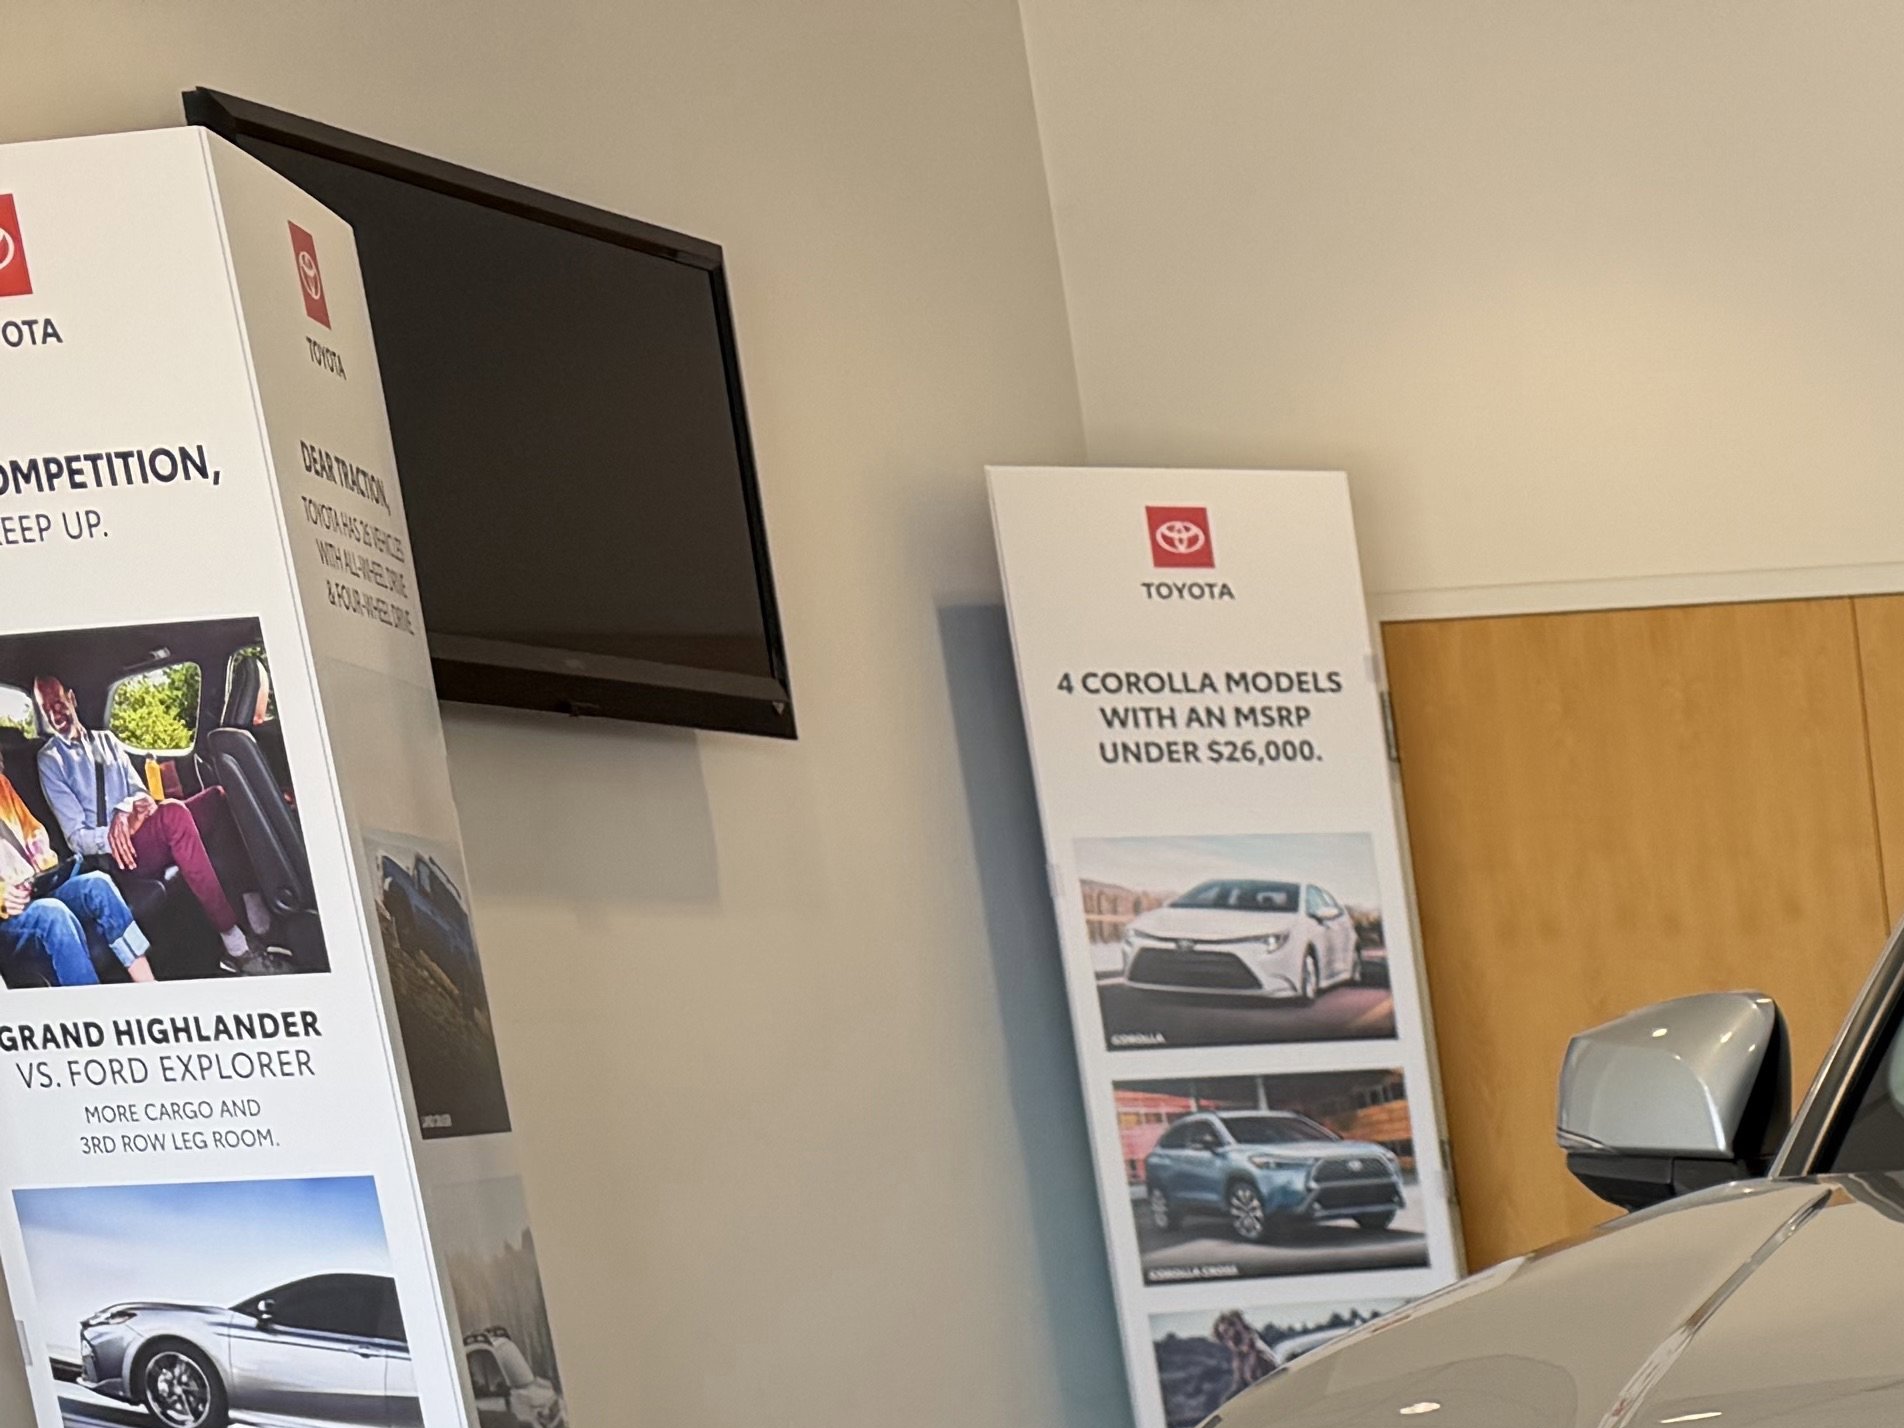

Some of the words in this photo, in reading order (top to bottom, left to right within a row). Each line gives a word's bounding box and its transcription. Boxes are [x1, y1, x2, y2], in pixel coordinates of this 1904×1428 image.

[306, 336, 347, 380] TOYOTA
[301, 439, 337, 485] DEAR
[334, 455, 391, 517] TRACTION,
[0, 513, 51, 545] EEP
[62, 510, 108, 539] UP.
[301, 495, 340, 533] TOYOTA
[340, 511, 362, 543] HAS
[316, 538, 344, 570] WITH
[1141, 582, 1236, 600] TOYOTA
[1057, 672, 1074, 694] 4
[1081, 671, 1218, 694] COROLLA
[1225, 671, 1343, 693] MODELS
[1099, 706, 1177, 729] WITH
[1185, 706, 1226, 728] AN
[1235, 705, 1311, 728] MSRP
[1099, 741, 1202, 764] UNDER
[1207, 739, 1323, 766] $26,000.
[0, 1021, 104, 1051] GRAND
[112, 1010, 322, 1046] HIGHLANDER
[16, 1061, 61, 1088] VS.
[67, 1057, 148, 1087] FORD
[160, 1049, 315, 1082] EXPLORER
[85, 1103, 140, 1124] MORE
[144, 1100, 213, 1122] CARGO
[220, 1098, 261, 1118] AND
[80, 1135, 116, 1154] 3RD
[121, 1132, 166, 1152] ROW
[171, 1131, 208, 1151] LEG
[212, 1128, 280, 1149] ROOM.
